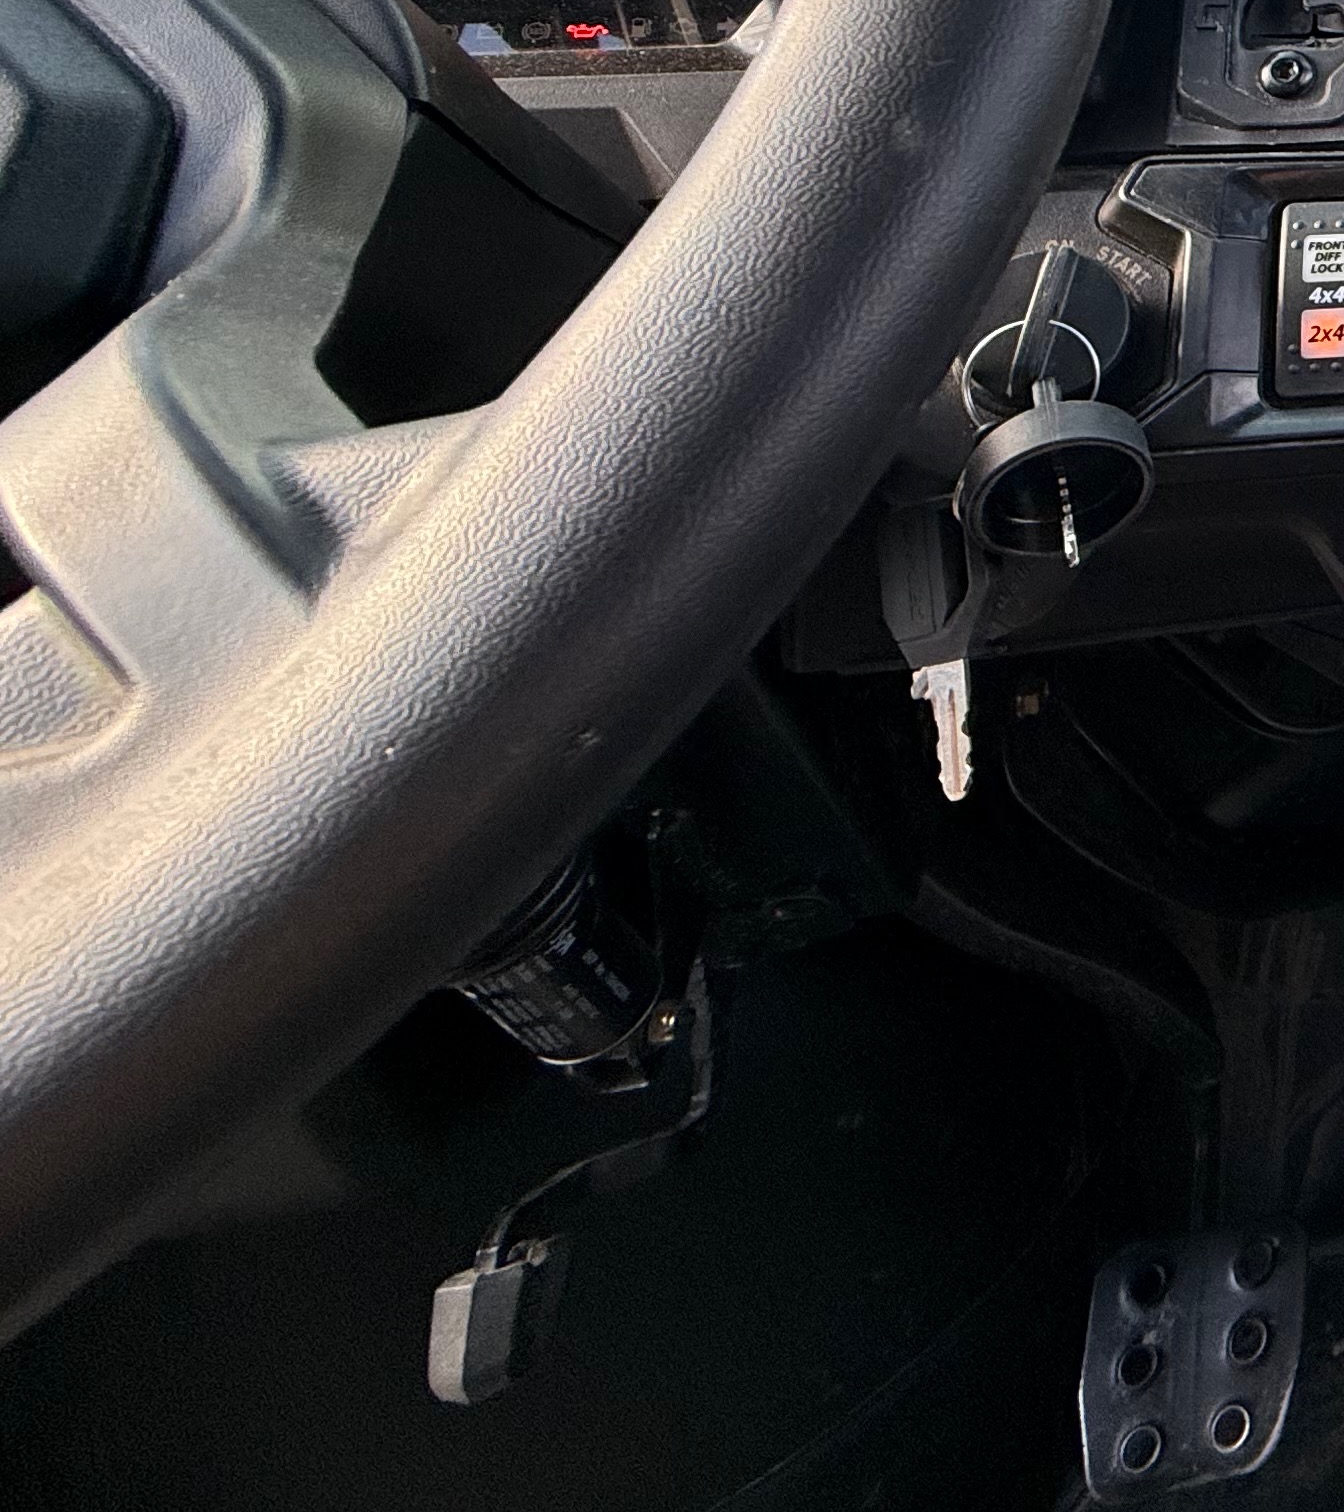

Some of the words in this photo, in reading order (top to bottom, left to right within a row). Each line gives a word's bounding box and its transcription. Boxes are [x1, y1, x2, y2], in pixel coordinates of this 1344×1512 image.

[1314, 251, 1342, 263] DIFF
[1096, 245, 1153, 287] START
[1310, 263, 1344, 274] LOCK
